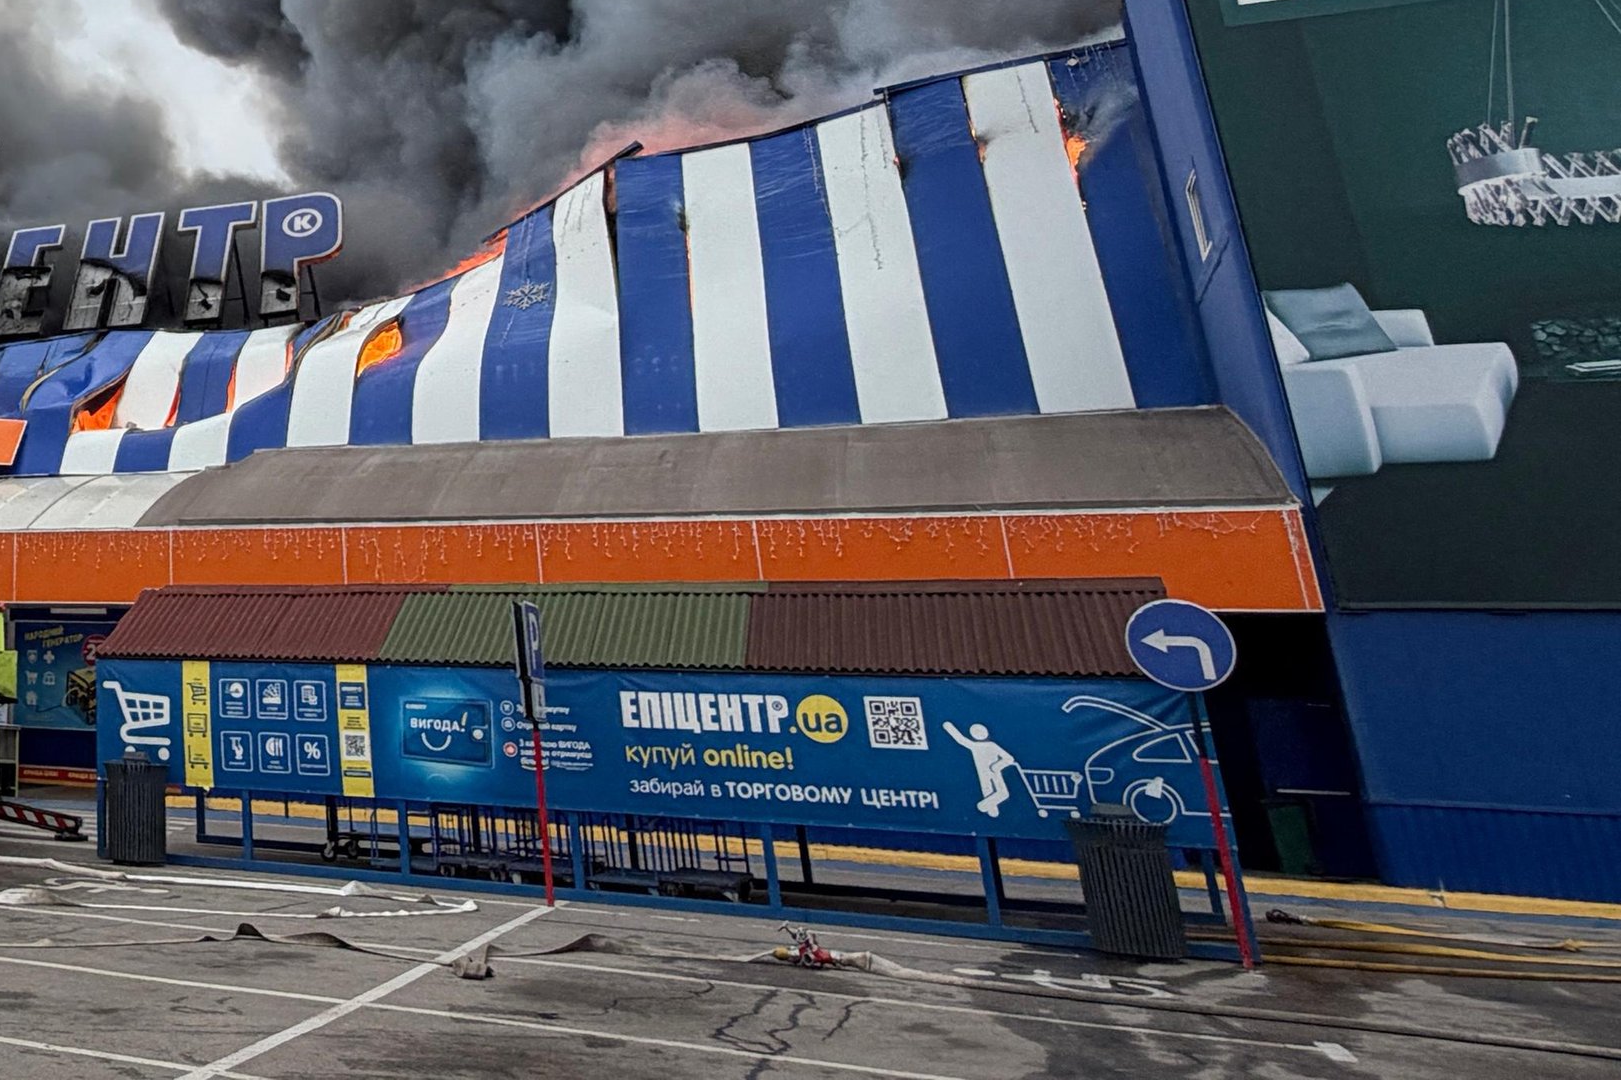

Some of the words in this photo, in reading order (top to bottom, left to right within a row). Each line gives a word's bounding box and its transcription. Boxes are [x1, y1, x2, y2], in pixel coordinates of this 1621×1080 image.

[410, 712, 468, 733] ВИГОДА!
[625, 743, 696, 770] купуй
[703, 744, 795, 770] online!
[630, 778, 705, 798] забирай
[711, 785, 722, 797] в
[725, 781, 852, 804] ТОРГОВОМУ
[860, 787, 940, 809] ЦЕНТРІ
